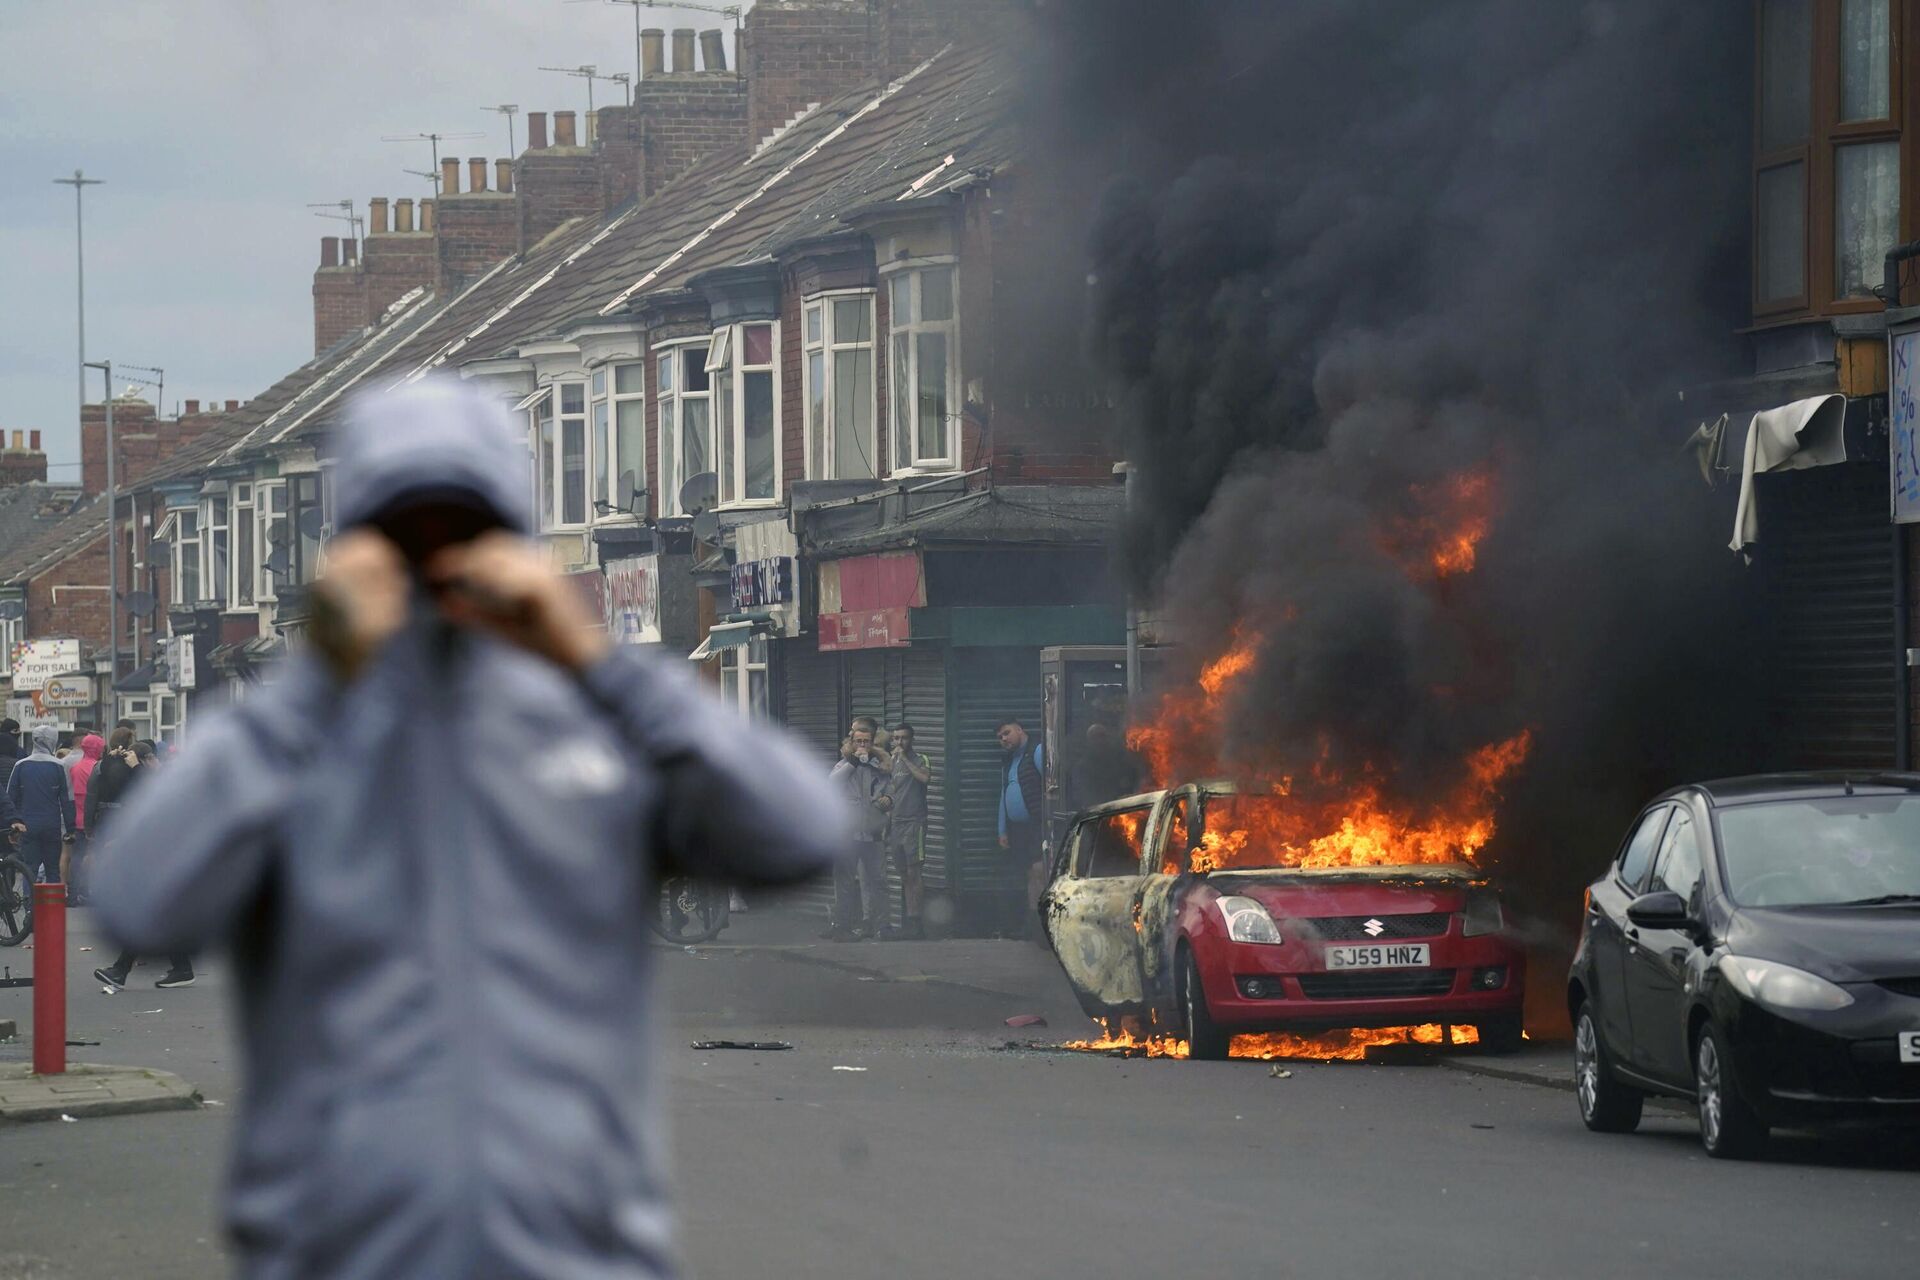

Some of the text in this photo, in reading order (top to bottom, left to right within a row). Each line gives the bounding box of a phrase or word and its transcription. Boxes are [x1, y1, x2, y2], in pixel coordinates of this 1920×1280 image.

[757, 556, 782, 605] STORE
[27, 662, 78, 673] FOR SALE
[24, 705, 35, 718] FIX
[1332, 947, 1423, 967] SJ59 HNZ
